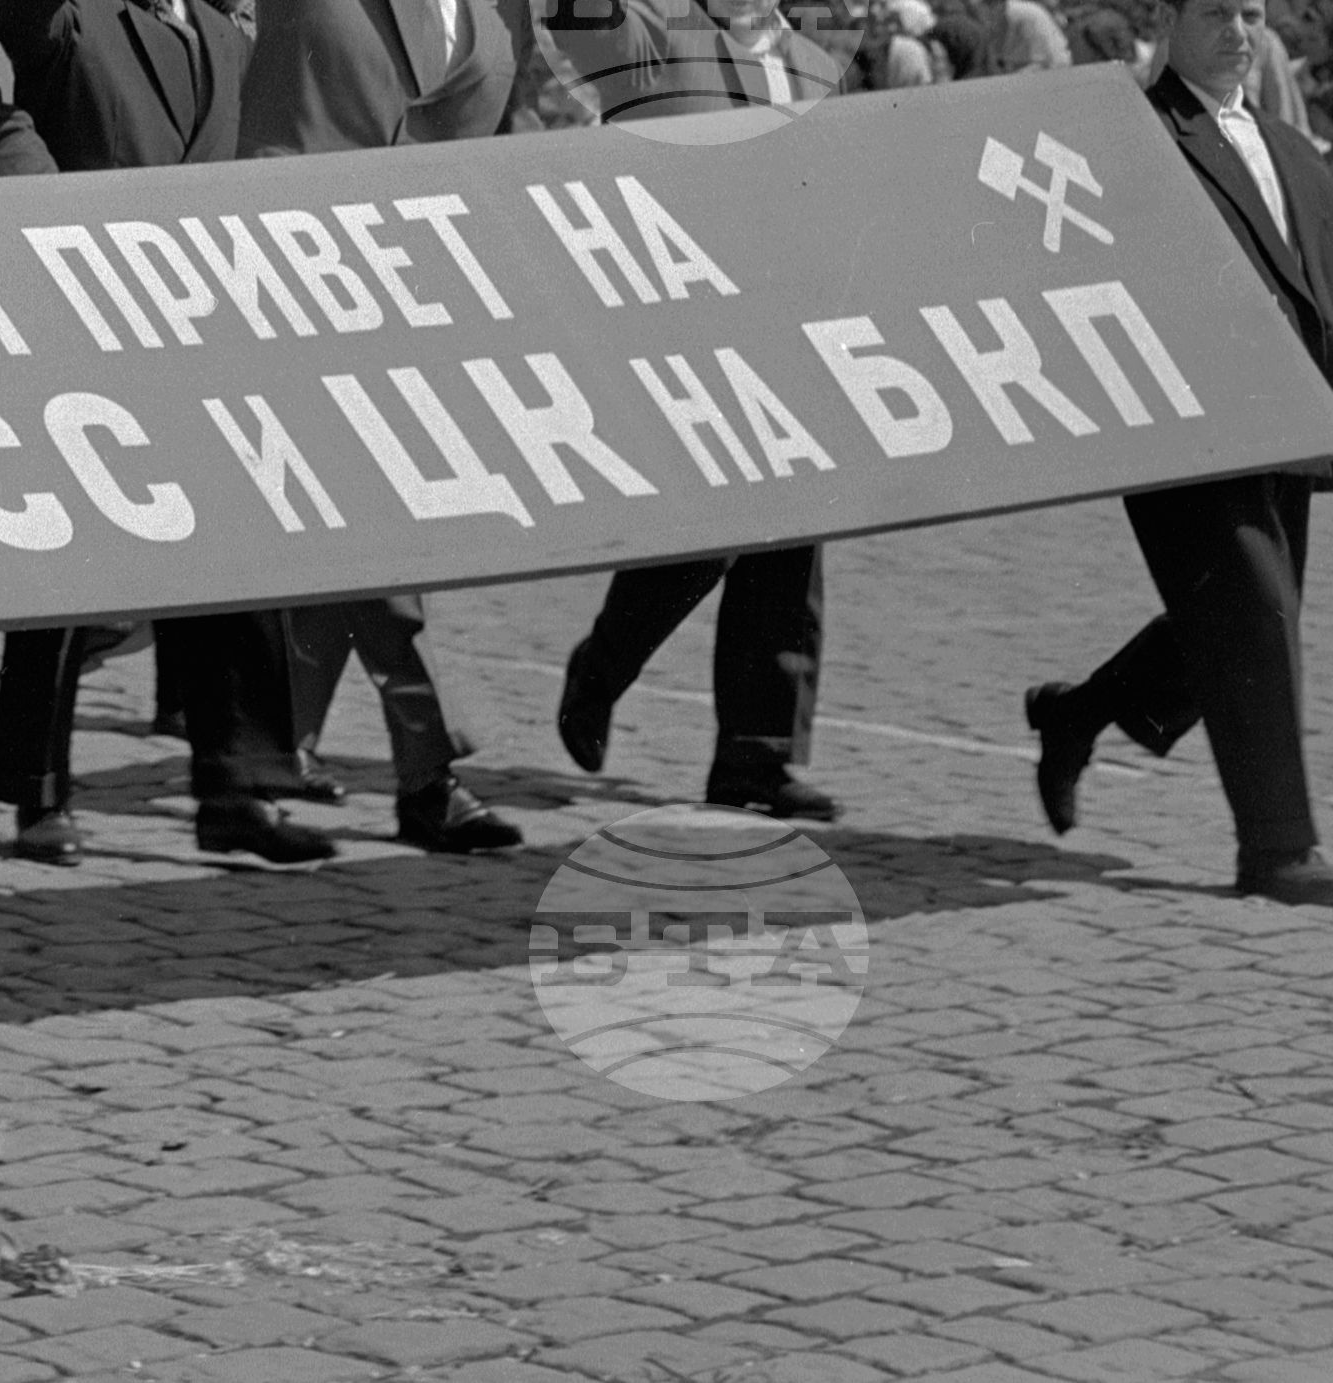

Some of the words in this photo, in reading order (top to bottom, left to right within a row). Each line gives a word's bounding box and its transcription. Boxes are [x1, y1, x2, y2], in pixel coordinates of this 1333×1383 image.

[20, 193, 513, 352] ПРИВЕТ
[526, 175, 740, 307] НА
[202, 395, 346, 532] И
[321, 352, 658, 527] ЦК
[629, 347, 836, 486] НА
[801, 281, 1204, 458] БКП
